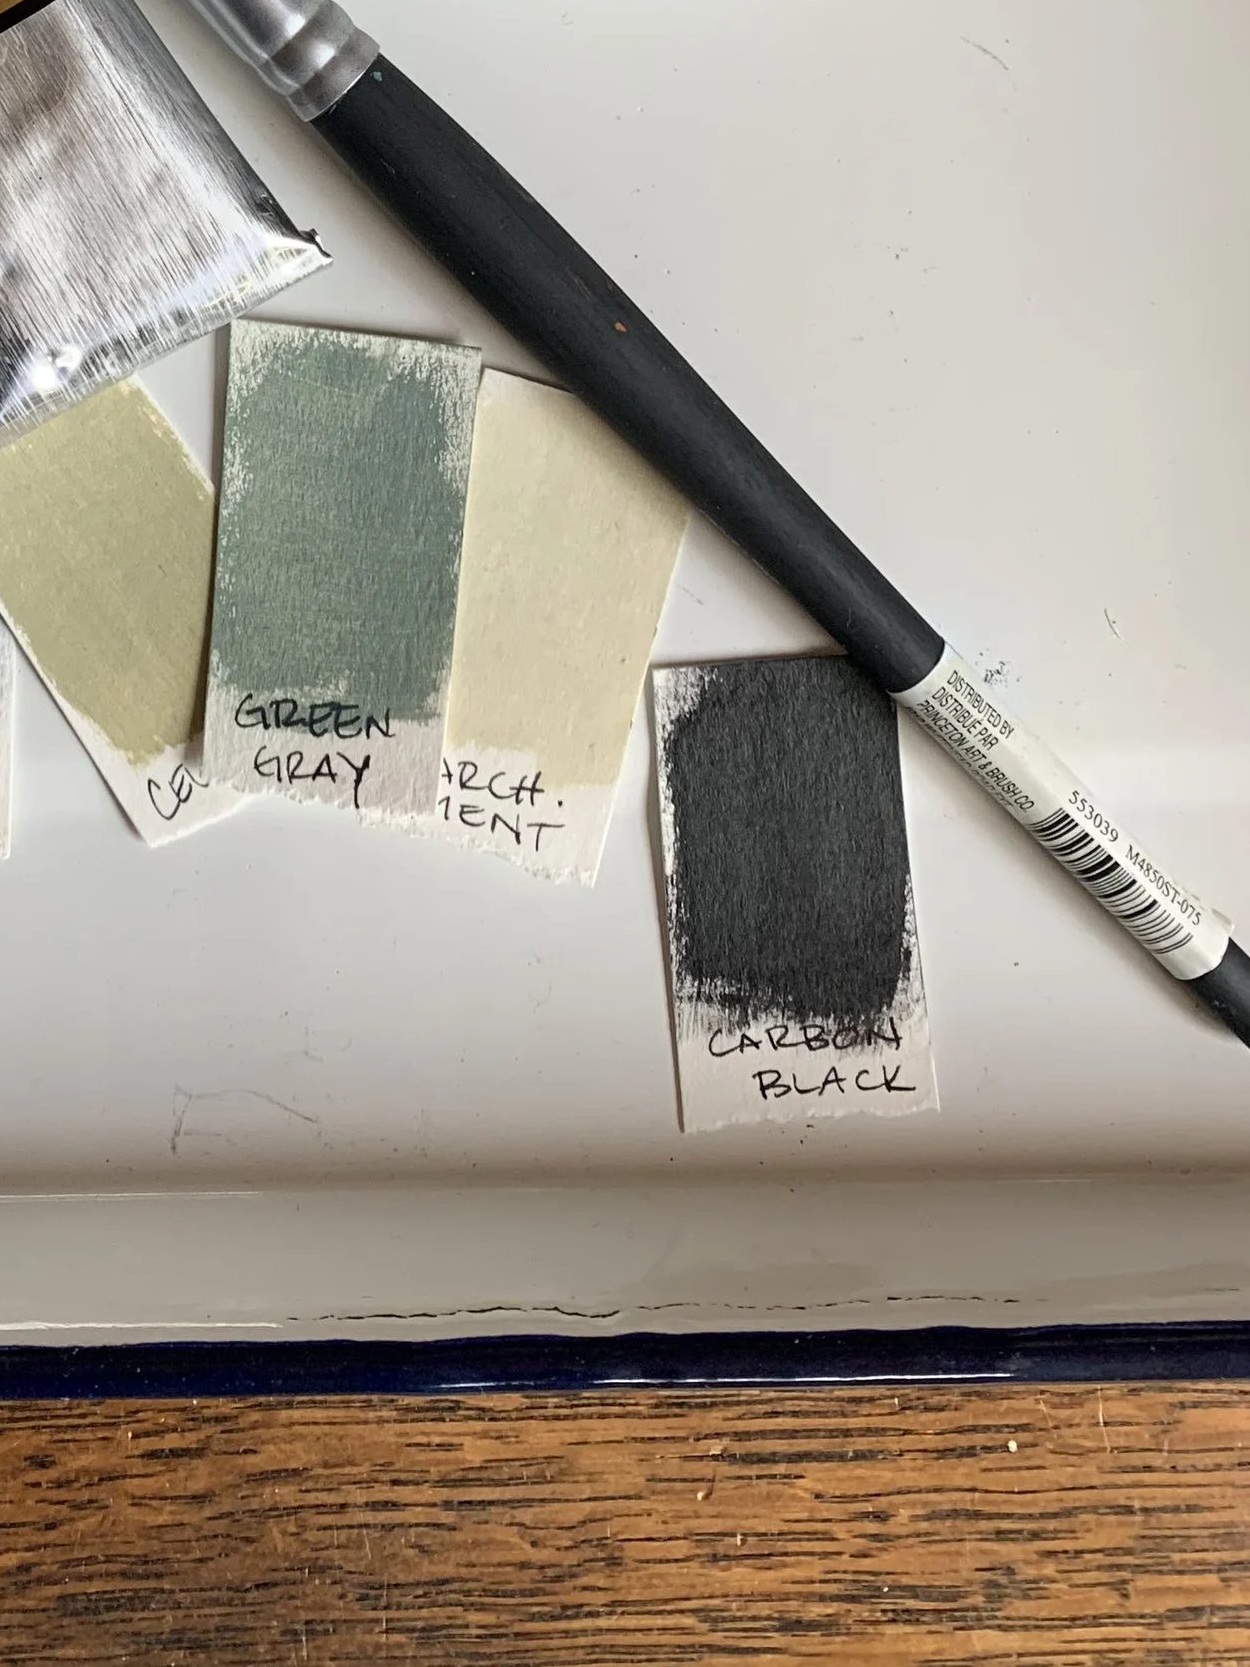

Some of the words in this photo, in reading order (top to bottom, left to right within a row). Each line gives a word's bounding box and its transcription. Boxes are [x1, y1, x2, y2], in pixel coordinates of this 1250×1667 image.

[234, 692, 397, 740] GREEN
[917, 699, 967, 748] PRINCETON
[946, 669, 1003, 729] DISTRIBUTED
[999, 719, 1015, 740] BY
[962, 743, 988, 765] ART
[975, 727, 999, 751] PAR
[254, 744, 371, 809] GRAY
[978, 760, 993, 771] &
[985, 767, 1022, 799] BRUSH
[1068, 789, 1120, 843] 553039
[1125, 843, 1203, 927] M4850ST-075
[708, 1016, 903, 1058] CARBON
[752, 1064, 916, 1100] BLACK
